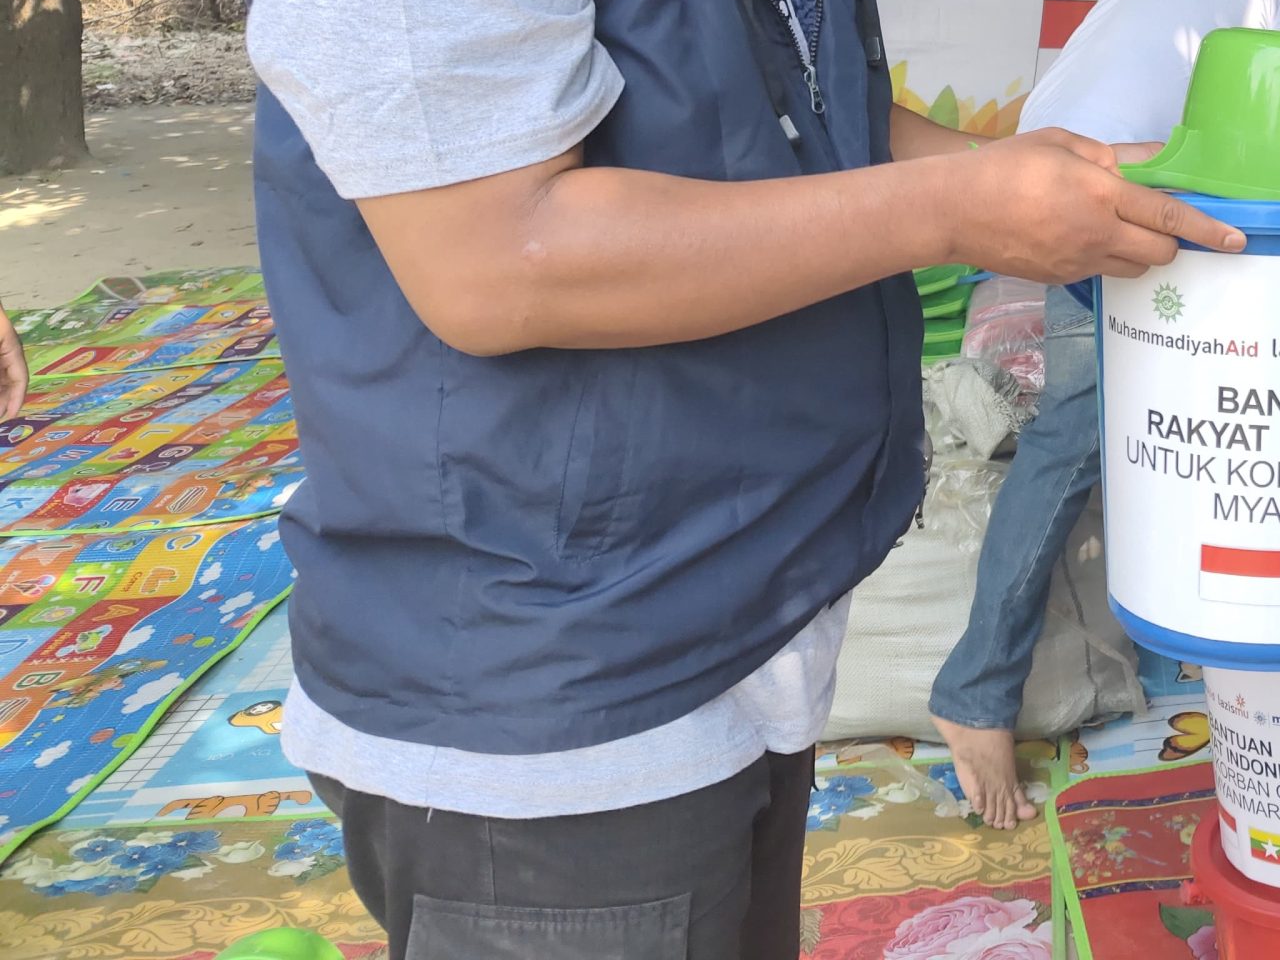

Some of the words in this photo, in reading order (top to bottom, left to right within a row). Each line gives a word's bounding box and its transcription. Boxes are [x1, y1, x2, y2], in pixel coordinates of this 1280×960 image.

[1108, 315, 1259, 358] MuhammadiyahAid
[1147, 408, 1270, 452] RAKYAT
[1126, 435, 1217, 484] UNTUK
[1217, 695, 1249, 720] lazismu
[1209, 710, 1273, 758] BANTUAN
